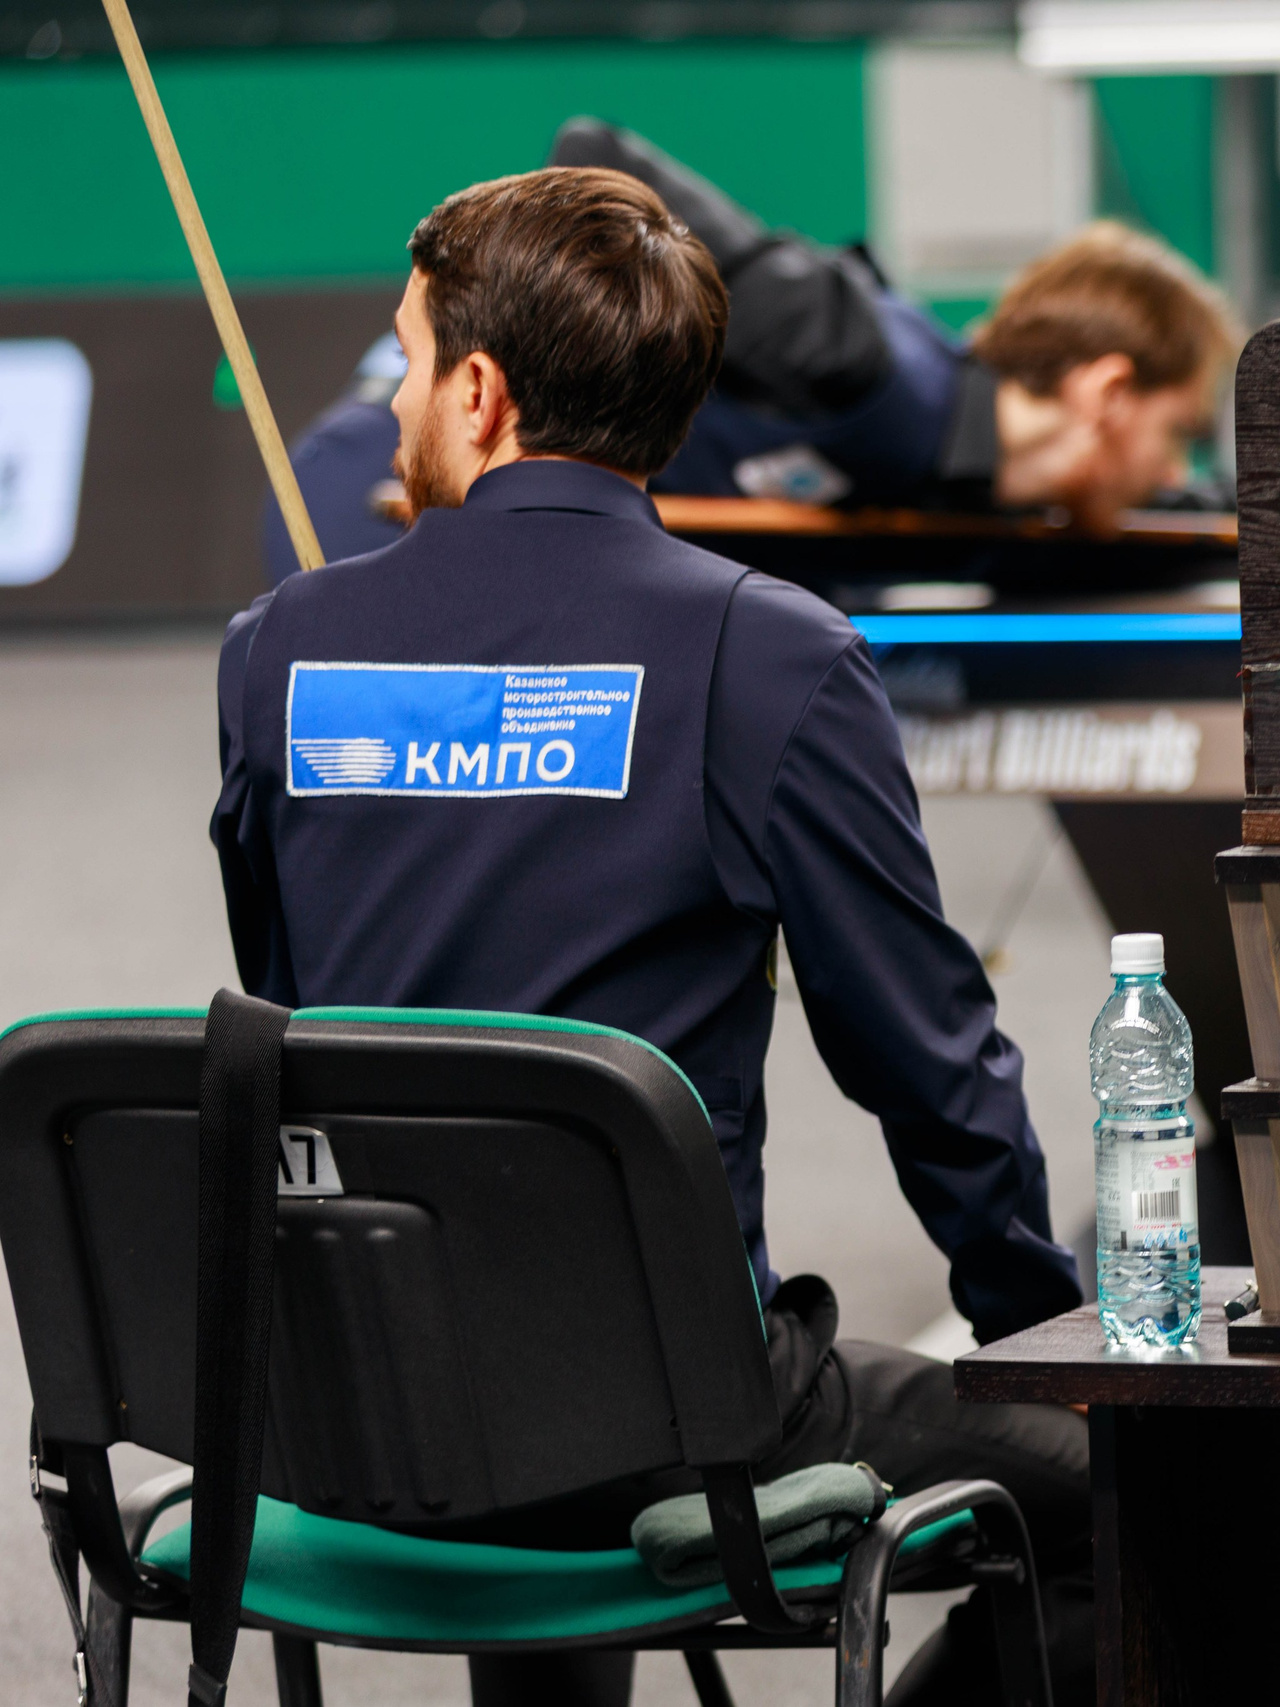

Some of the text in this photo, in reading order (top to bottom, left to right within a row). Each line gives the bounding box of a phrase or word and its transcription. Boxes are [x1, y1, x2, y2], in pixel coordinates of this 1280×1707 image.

[505, 674, 568, 688] Казанское
[503, 690, 630, 705] моторостроительное
[502, 704, 612, 720] производственное
[501, 719, 576, 733] объединение
[404, 739, 576, 786] КМПО
